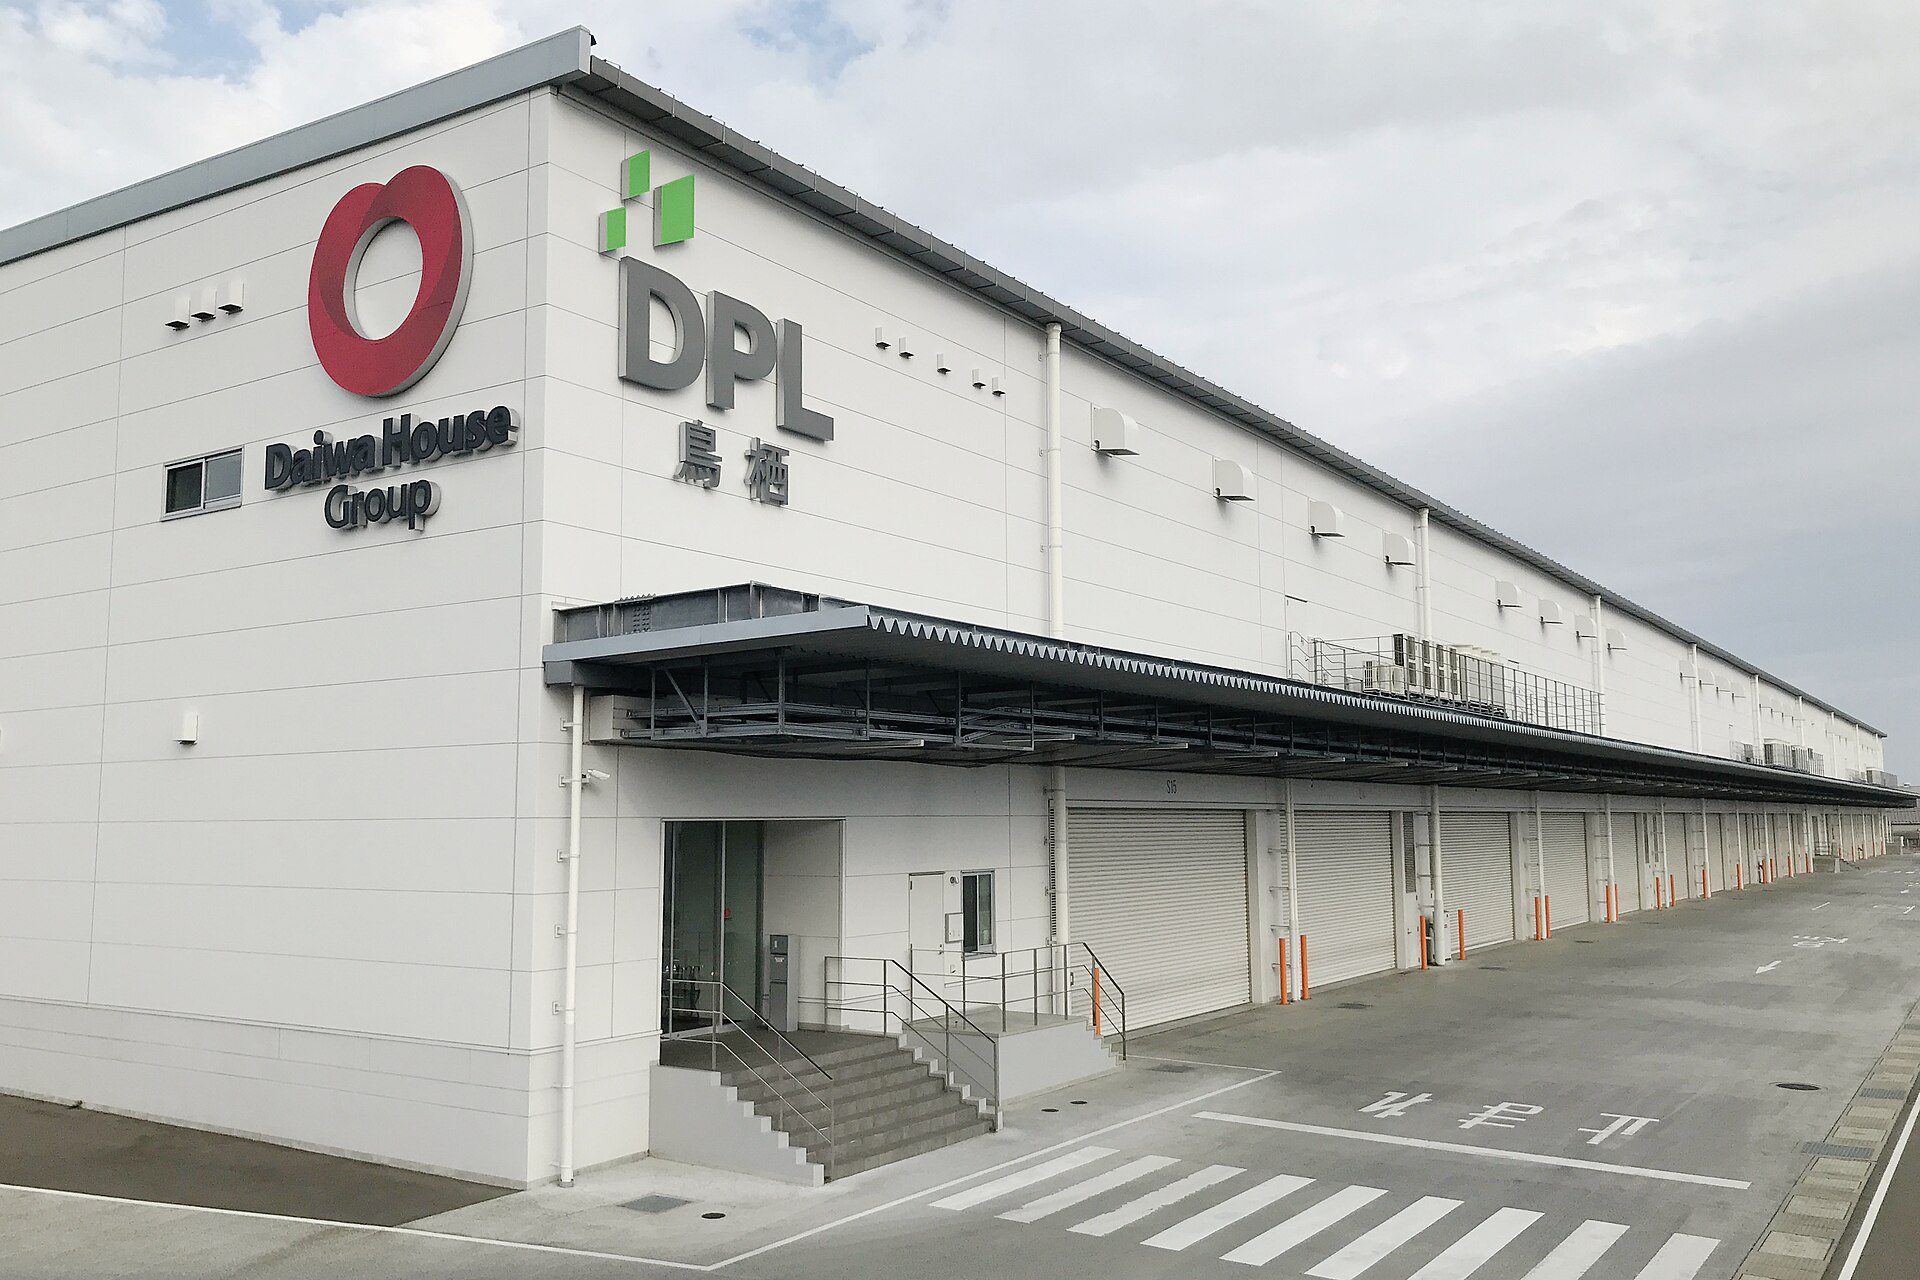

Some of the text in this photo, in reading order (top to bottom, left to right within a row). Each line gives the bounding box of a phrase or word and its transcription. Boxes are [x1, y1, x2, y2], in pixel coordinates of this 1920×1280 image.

[618, 255, 834, 442] DPL
[264, 405, 519, 490] Daiwa House
[674, 419, 790, 506] 鳥栖
[324, 479, 440, 531] Group
